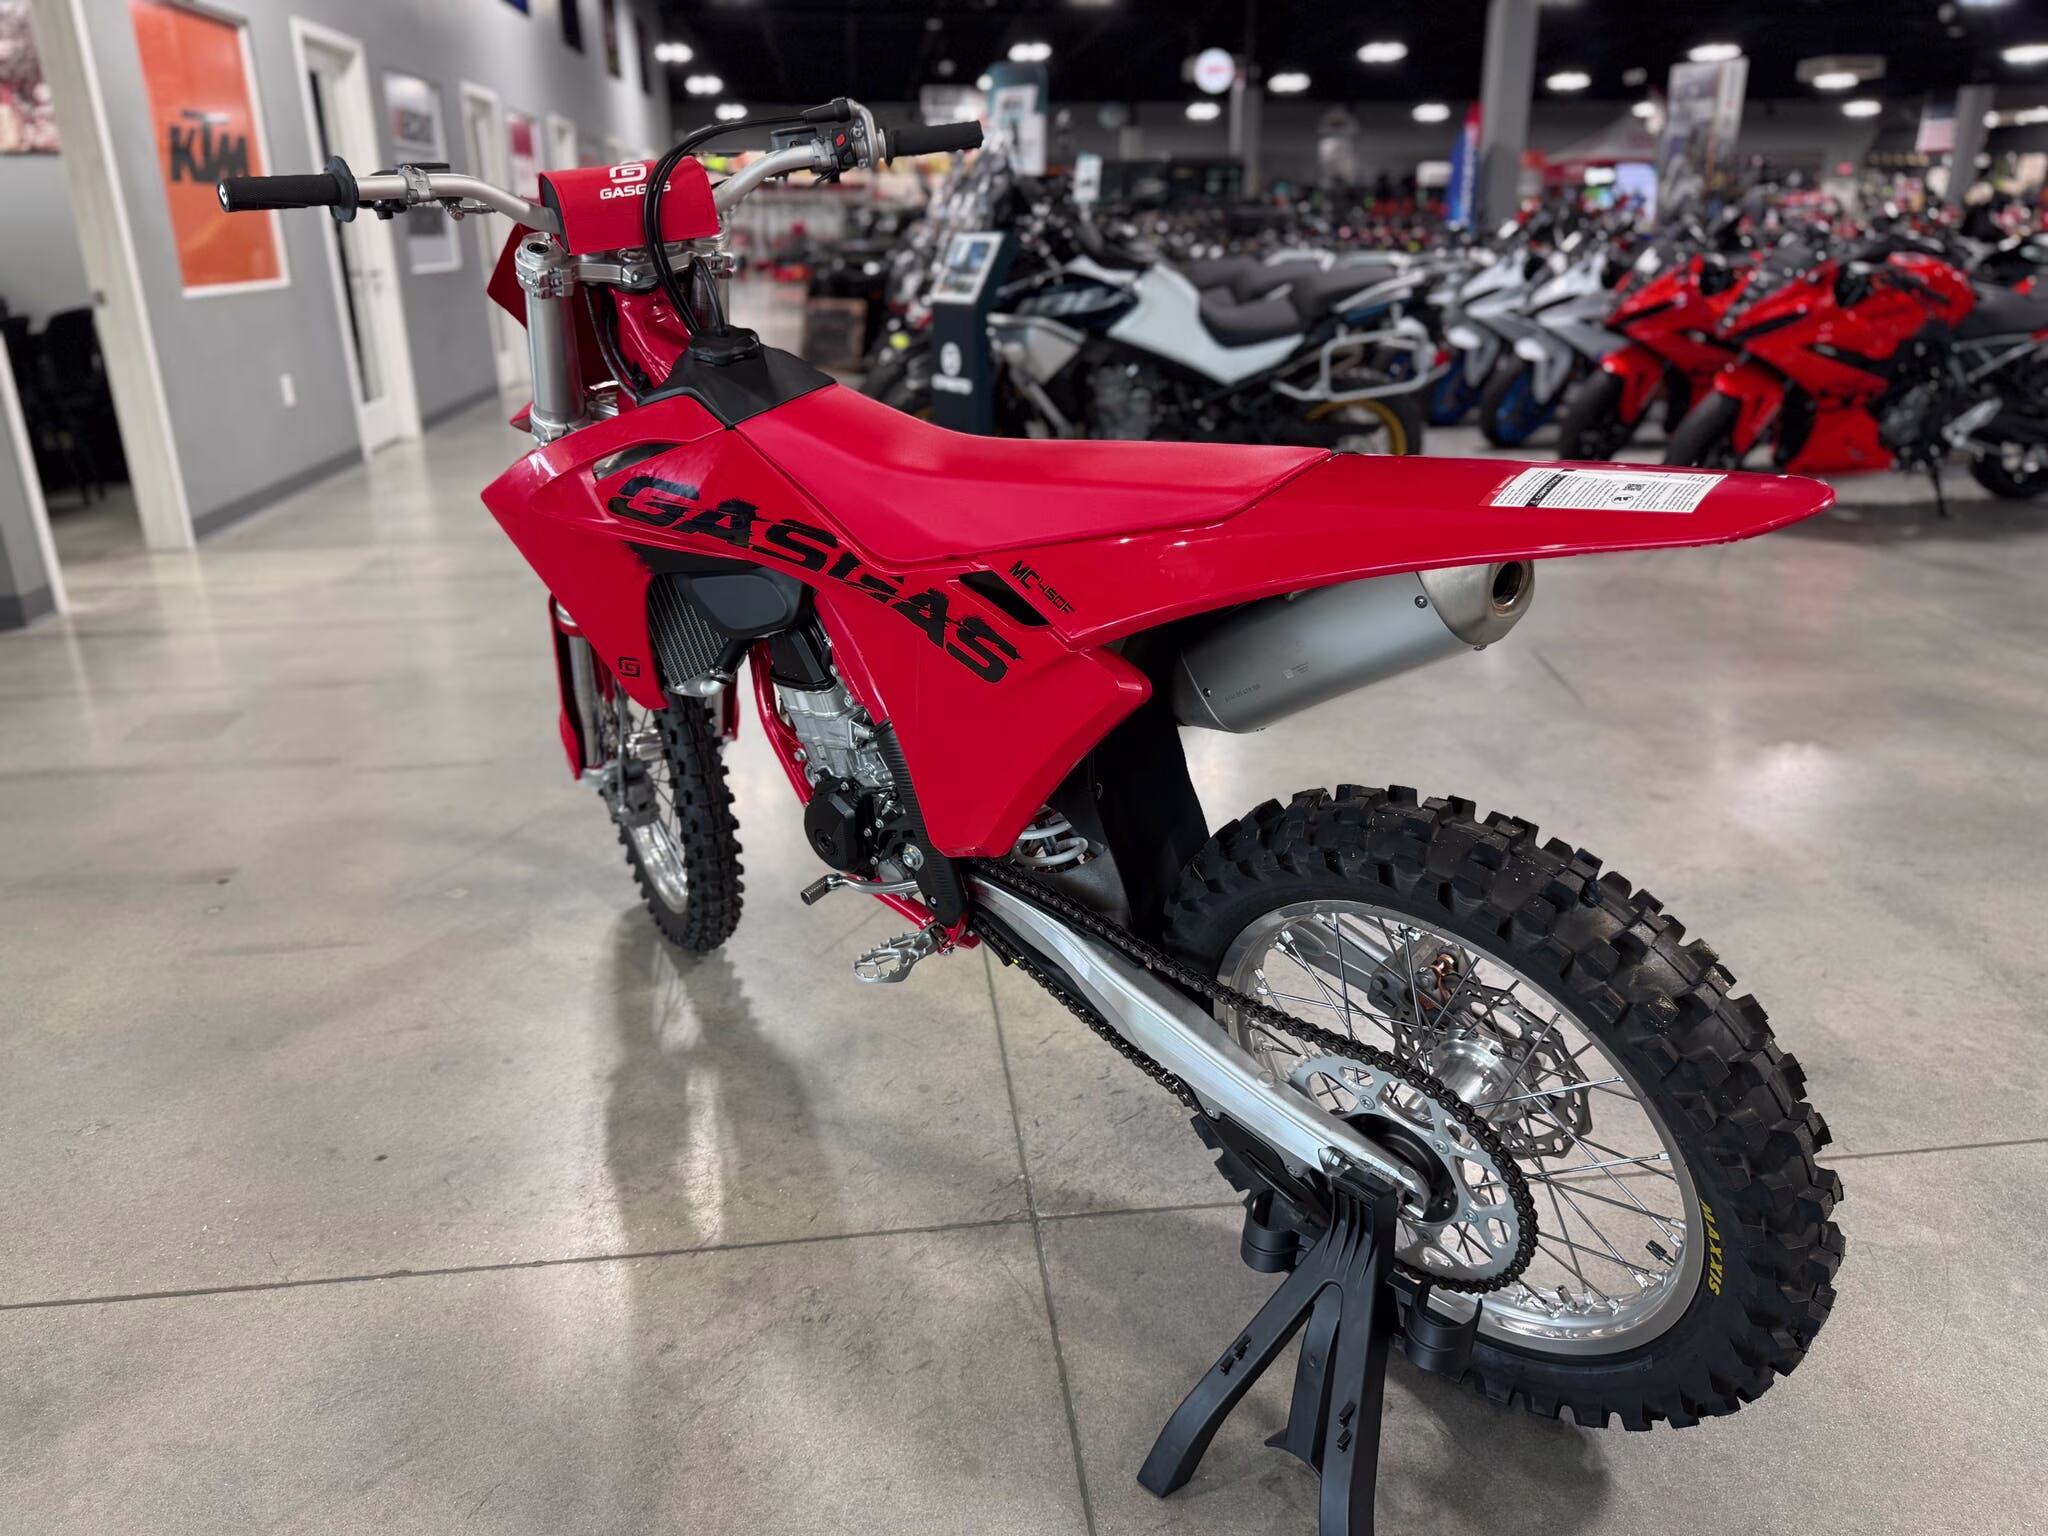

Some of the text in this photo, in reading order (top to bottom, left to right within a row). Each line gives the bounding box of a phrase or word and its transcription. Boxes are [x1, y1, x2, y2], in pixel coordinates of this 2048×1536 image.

[169, 109, 248, 182] KTM
[600, 181, 671, 200] GASGS
[1699, 1197, 1722, 1296] MAXXIS
